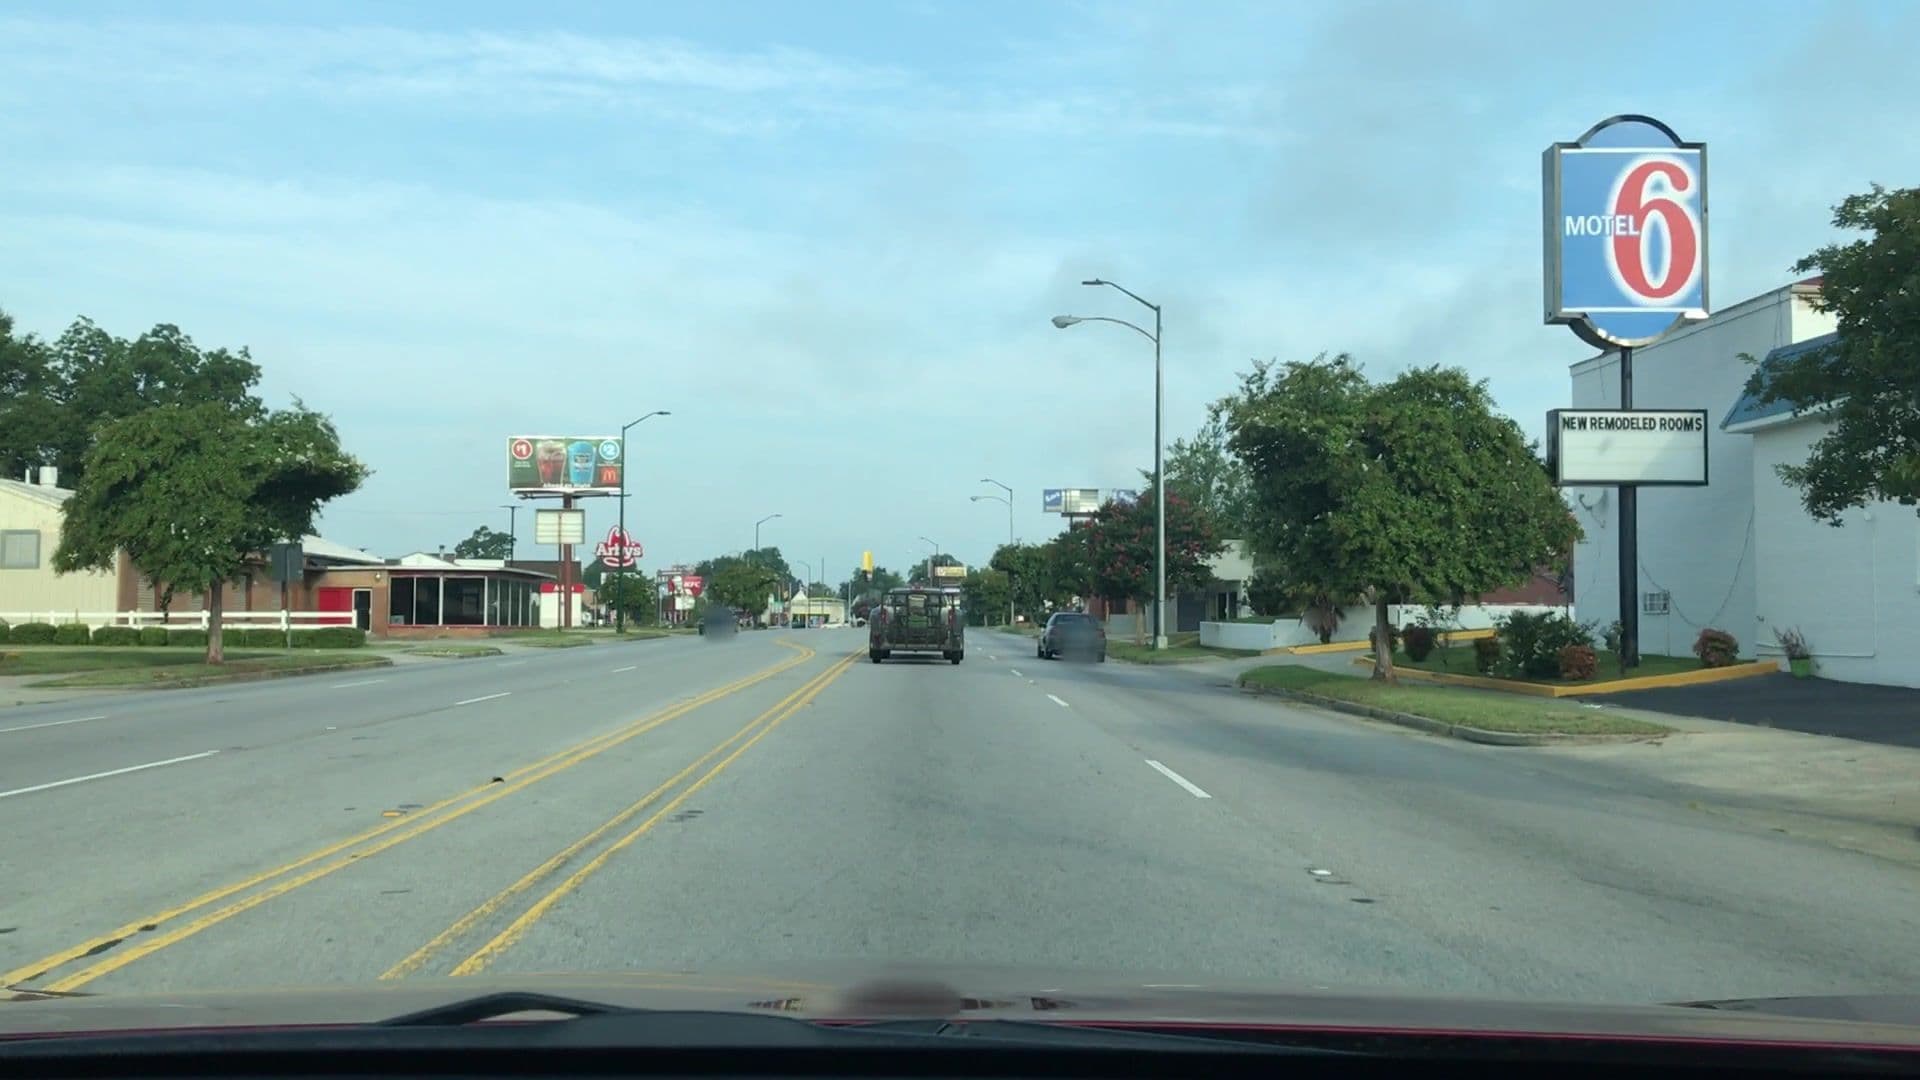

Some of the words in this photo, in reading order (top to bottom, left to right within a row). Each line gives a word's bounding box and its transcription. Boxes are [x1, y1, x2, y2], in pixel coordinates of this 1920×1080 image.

[1565, 214, 1640, 237] MOTEL
[1612, 159, 1698, 300] 6
[1562, 416, 1587, 430] NEW
[1590, 416, 1656, 431] REMODELED
[1659, 417, 1703, 431] ROOMS
[683, 581, 702, 589] KFC
